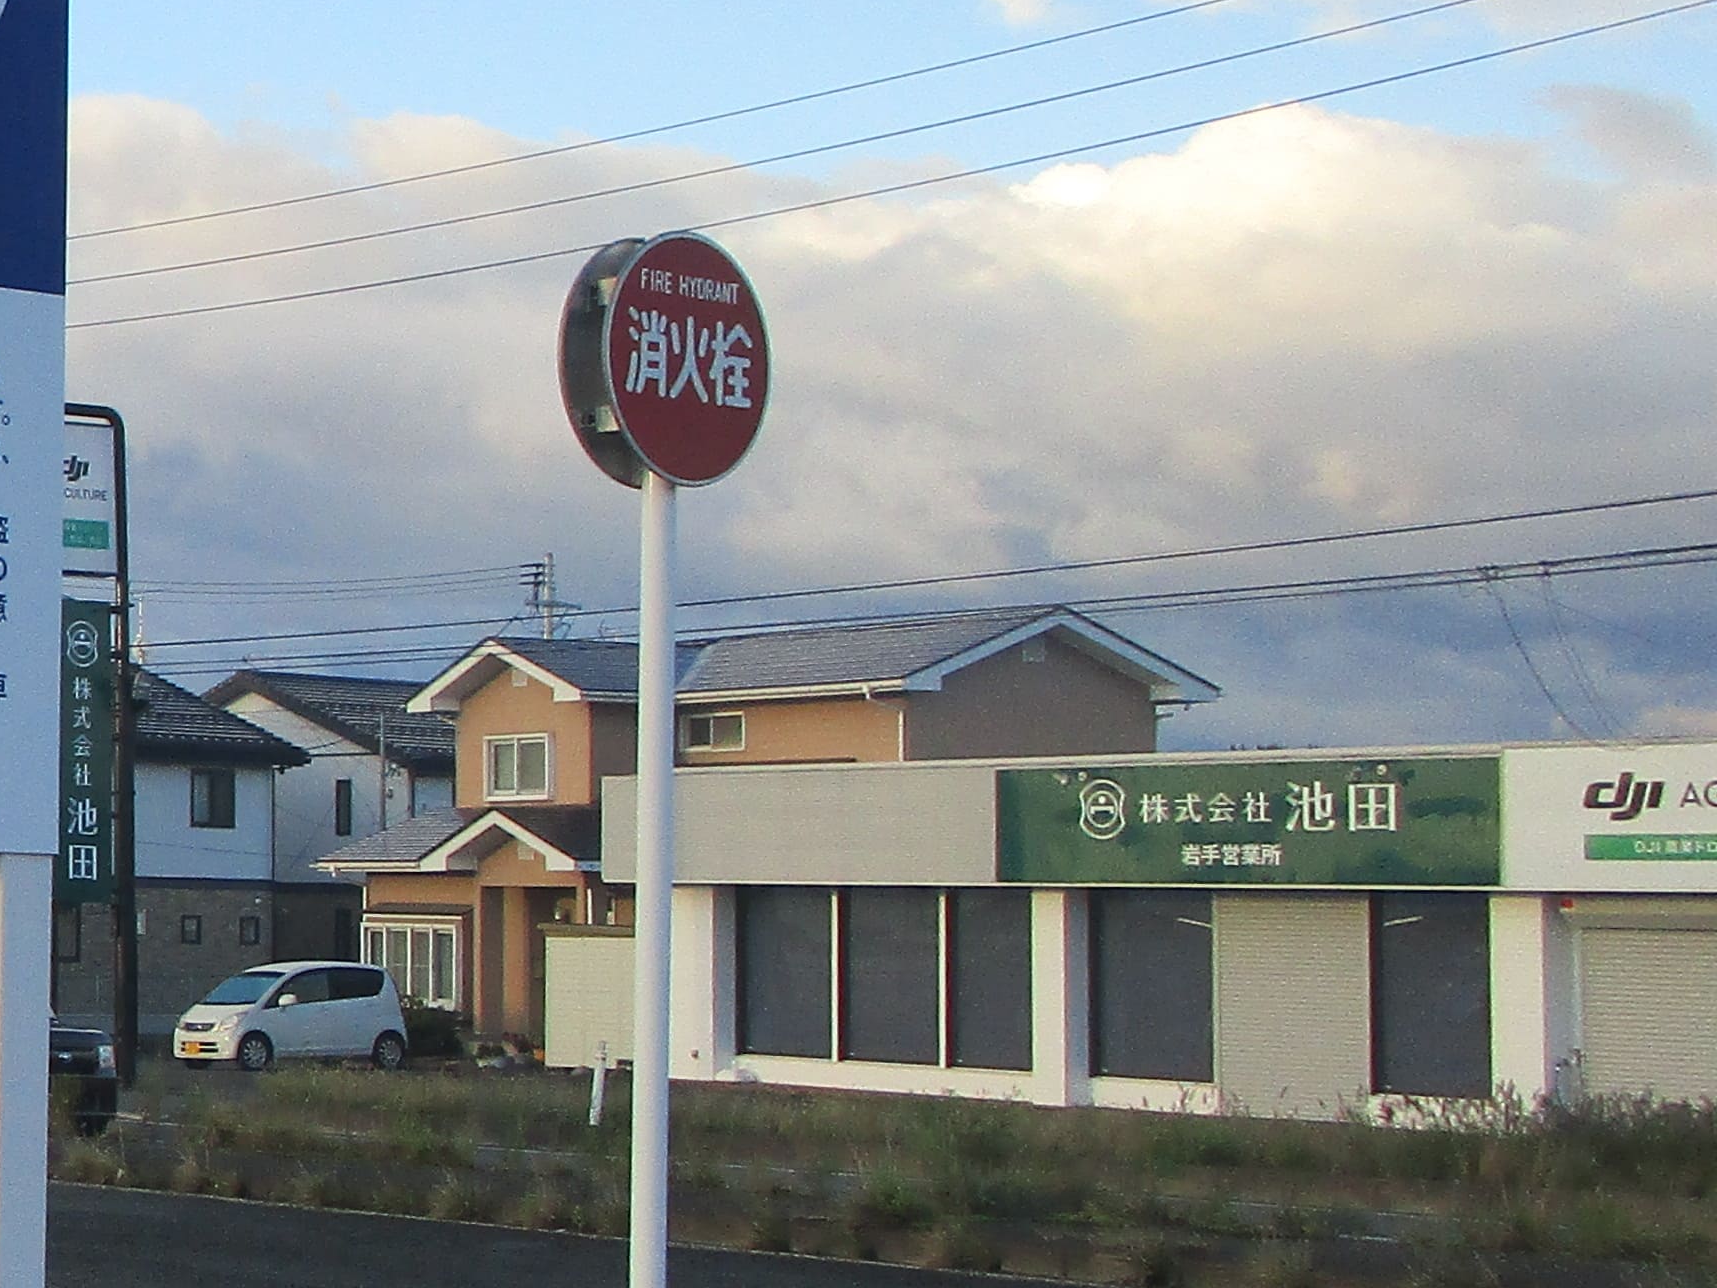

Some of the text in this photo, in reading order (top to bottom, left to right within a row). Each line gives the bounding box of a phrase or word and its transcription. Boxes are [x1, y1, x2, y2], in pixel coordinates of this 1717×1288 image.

[641, 268, 739, 304] FIRE HYDRANT
[626, 306, 753, 408] 消火栓
[1181, 843, 1283, 866] 岩手営業所
